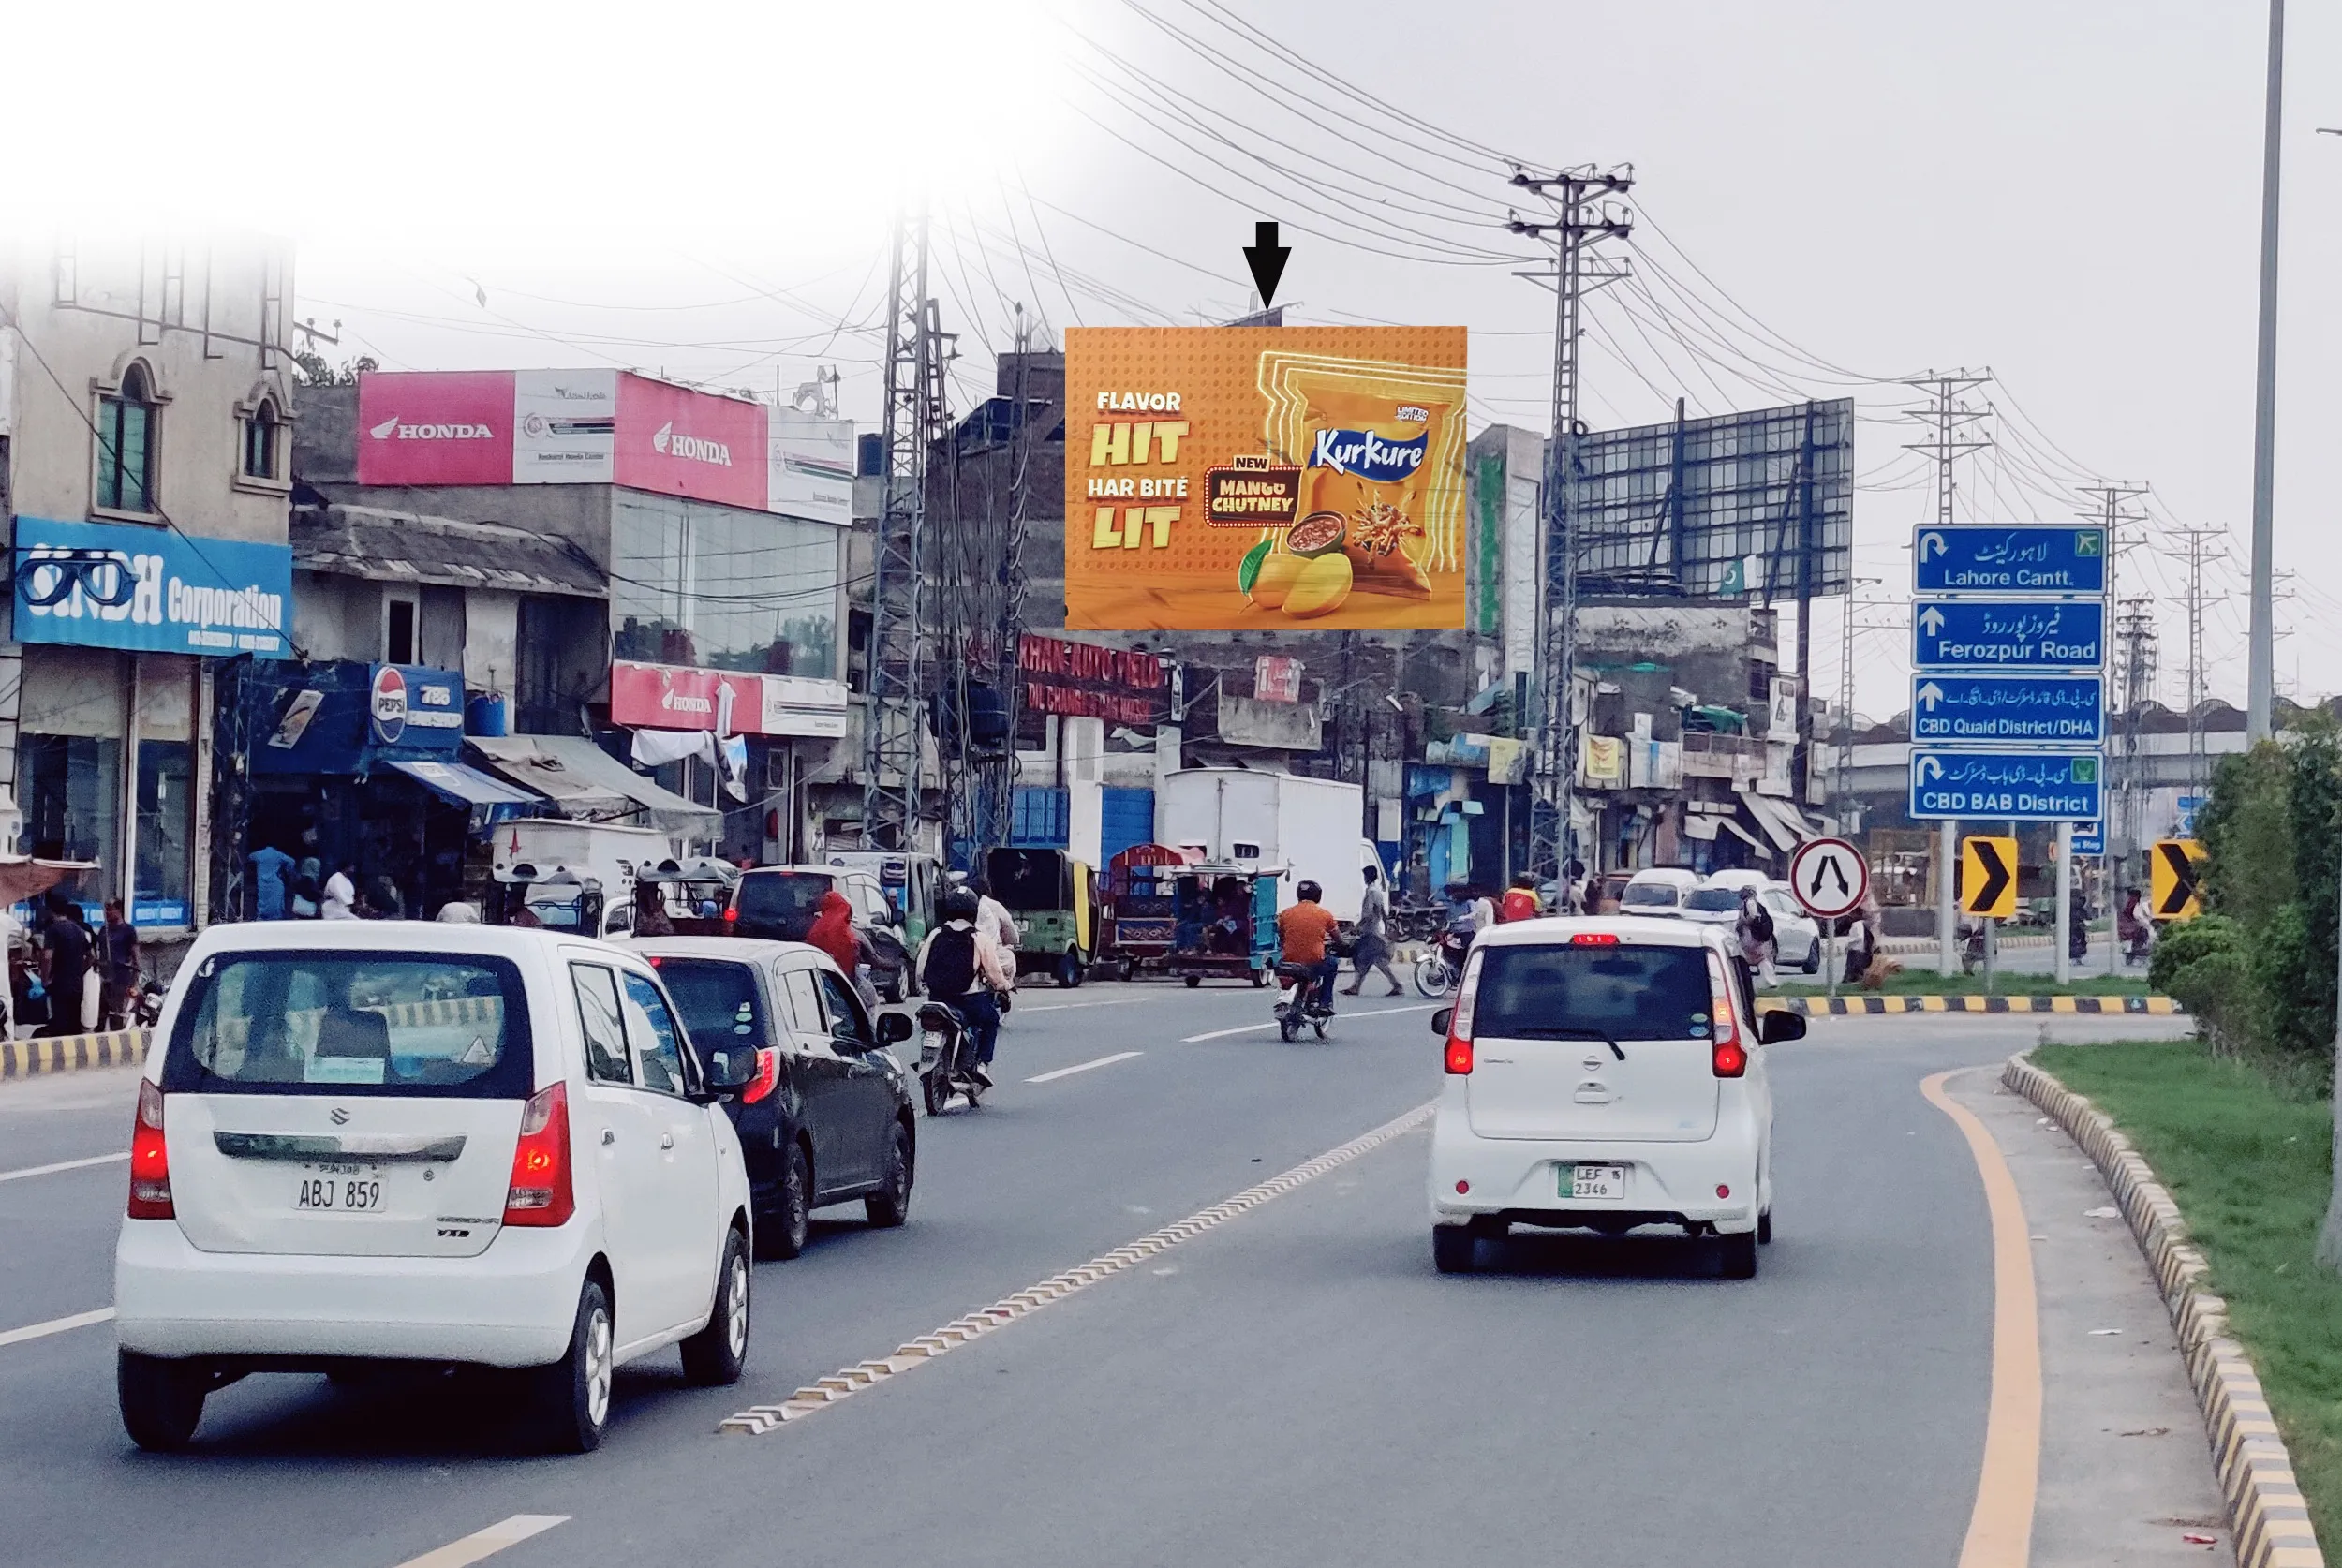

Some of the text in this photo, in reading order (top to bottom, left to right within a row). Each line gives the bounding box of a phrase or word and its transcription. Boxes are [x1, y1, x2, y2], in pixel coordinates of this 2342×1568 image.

[1096, 392, 1181, 412] FLAVOR
[398, 424, 494, 439] HONDA
[671, 434, 732, 466] HONDA
[1089, 421, 1191, 466] HIT
[1236, 457, 1267, 469] NEW
[1088, 479, 1134, 497] HAR
[1220, 479, 1286, 496] MANGO
[1211, 497, 1294, 512] CHUTNEY
[1092, 506, 1181, 549] LIT
[1944, 569, 2075, 586] Lahore Cantt.
[167, 576, 282, 629] Corporation
[1938, 641, 2097, 662] Ferozpur Road
[378, 697, 406, 713] PEPSI
[674, 695, 713, 713] HONDA
[1919, 718, 1950, 734] CBD
[1954, 718, 1996, 735] Quaid
[1922, 792, 2089, 812] CBD BAB District
[1577, 1168, 1603, 1180] LEF
[298, 1179, 380, 1208] ABJ 859
